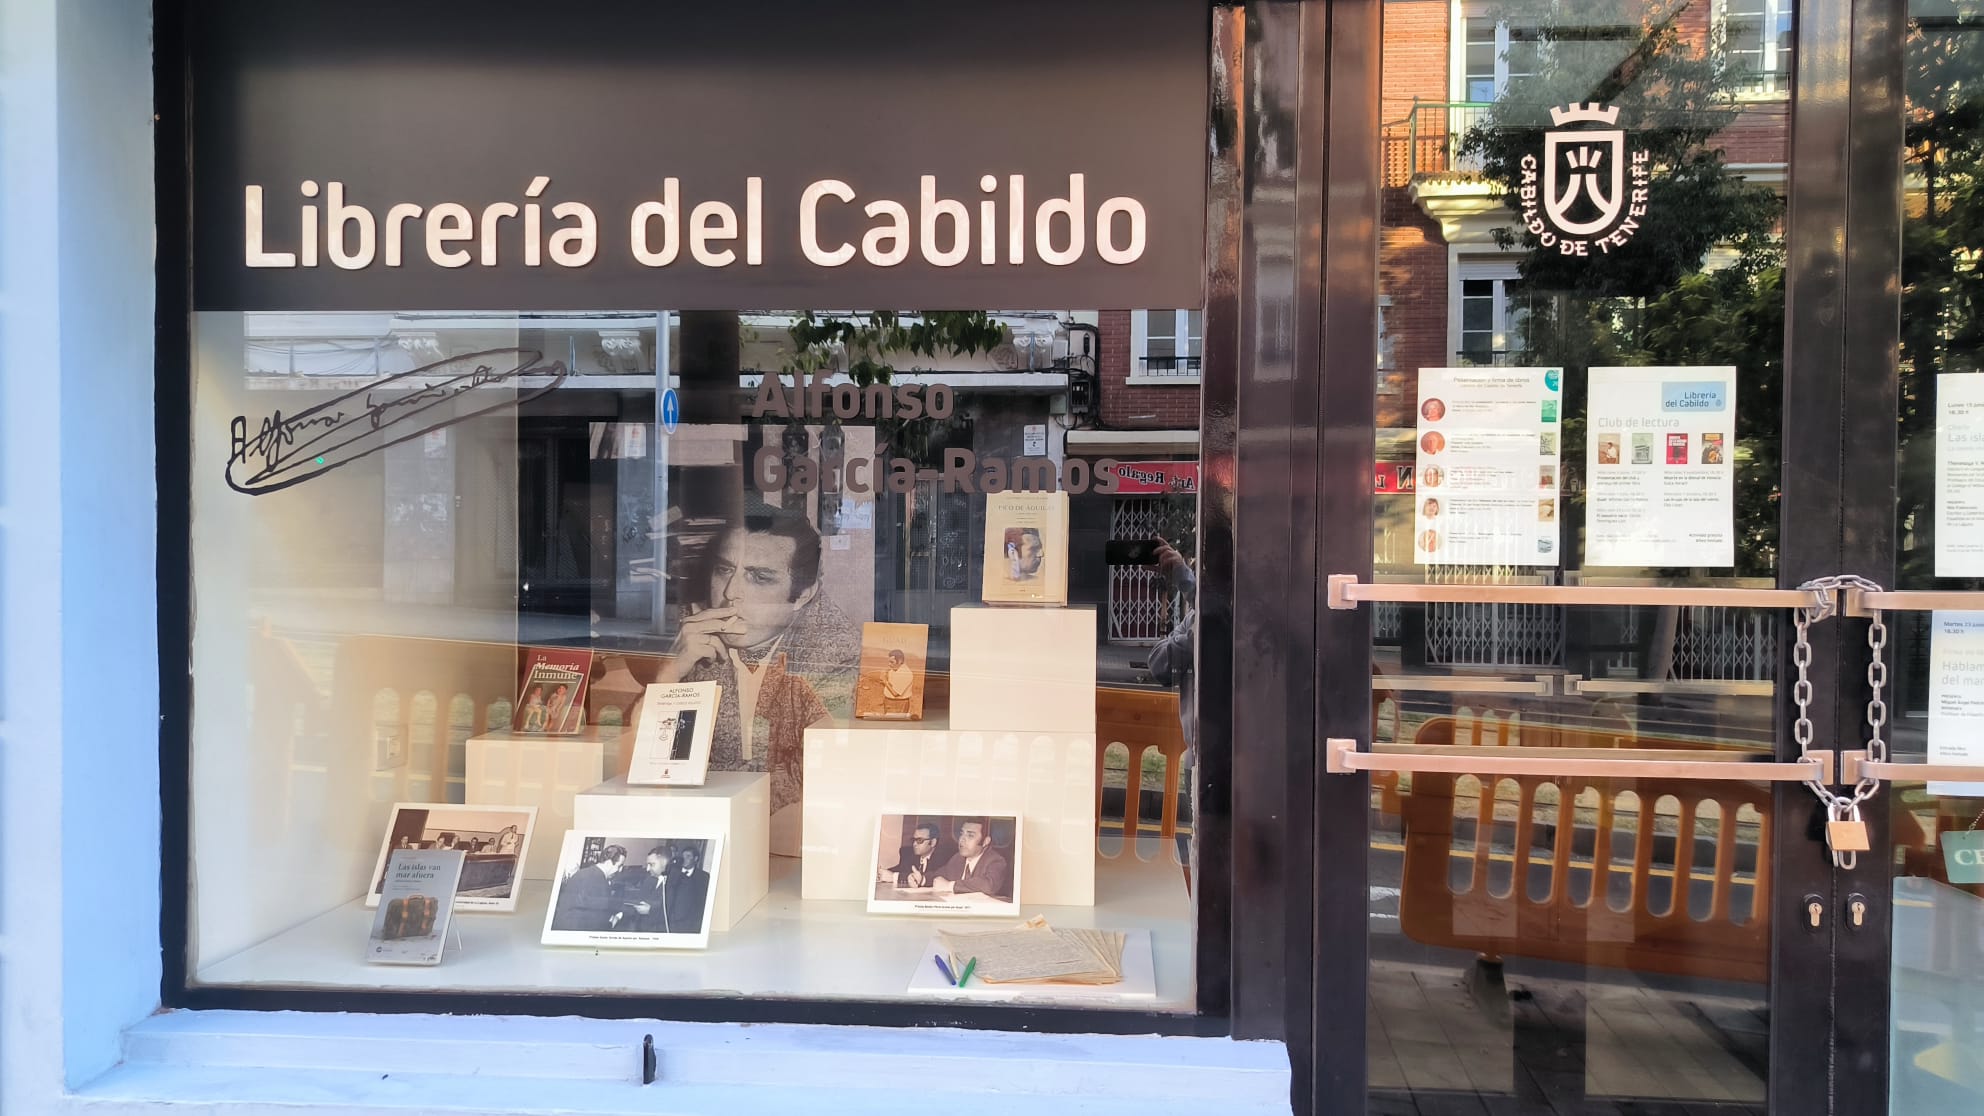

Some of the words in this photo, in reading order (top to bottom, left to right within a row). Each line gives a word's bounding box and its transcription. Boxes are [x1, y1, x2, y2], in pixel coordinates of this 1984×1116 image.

[244, 175, 598, 270] Librería
[630, 176, 763, 268] del
[799, 172, 1147, 268] Cabildo
[1520, 153, 1557, 247] CABILDO
[1559, 238, 1589, 257] DE
[1594, 149, 1650, 254] TENERIFE
[751, 367, 955, 420] Alfonso
[1598, 417, 1623, 428] Club
[1625, 417, 1639, 428] de
[1641, 417, 1680, 428] lectura
[752, 441, 1122, 495] García-Ramos
[534, 662, 580, 672] Memoria
